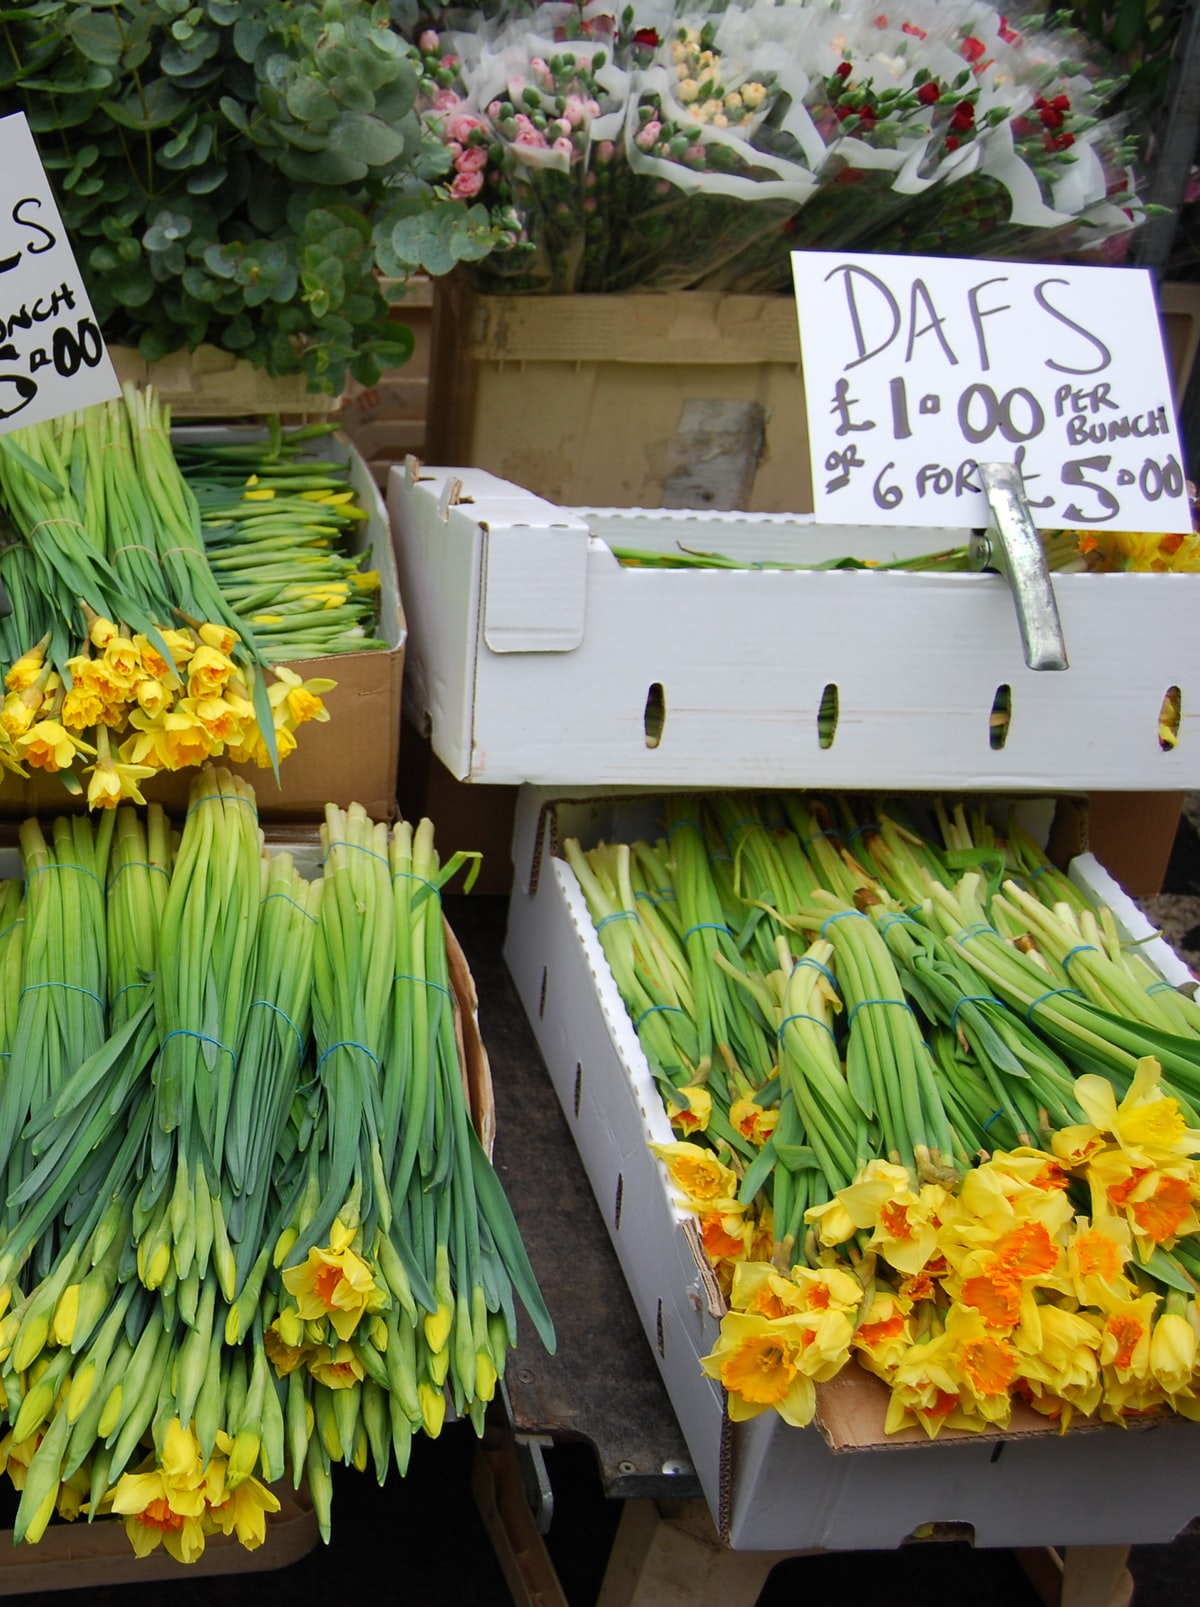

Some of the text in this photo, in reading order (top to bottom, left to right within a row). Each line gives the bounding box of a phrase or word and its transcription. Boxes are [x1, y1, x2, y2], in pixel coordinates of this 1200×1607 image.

[824, 263, 1112, 375] DAFS
[1054, 382, 1120, 417] PER
[1066, 405, 1170, 445] BUNCH
[872, 461, 904, 510] 6
[916, 458, 983, 498] FOR
